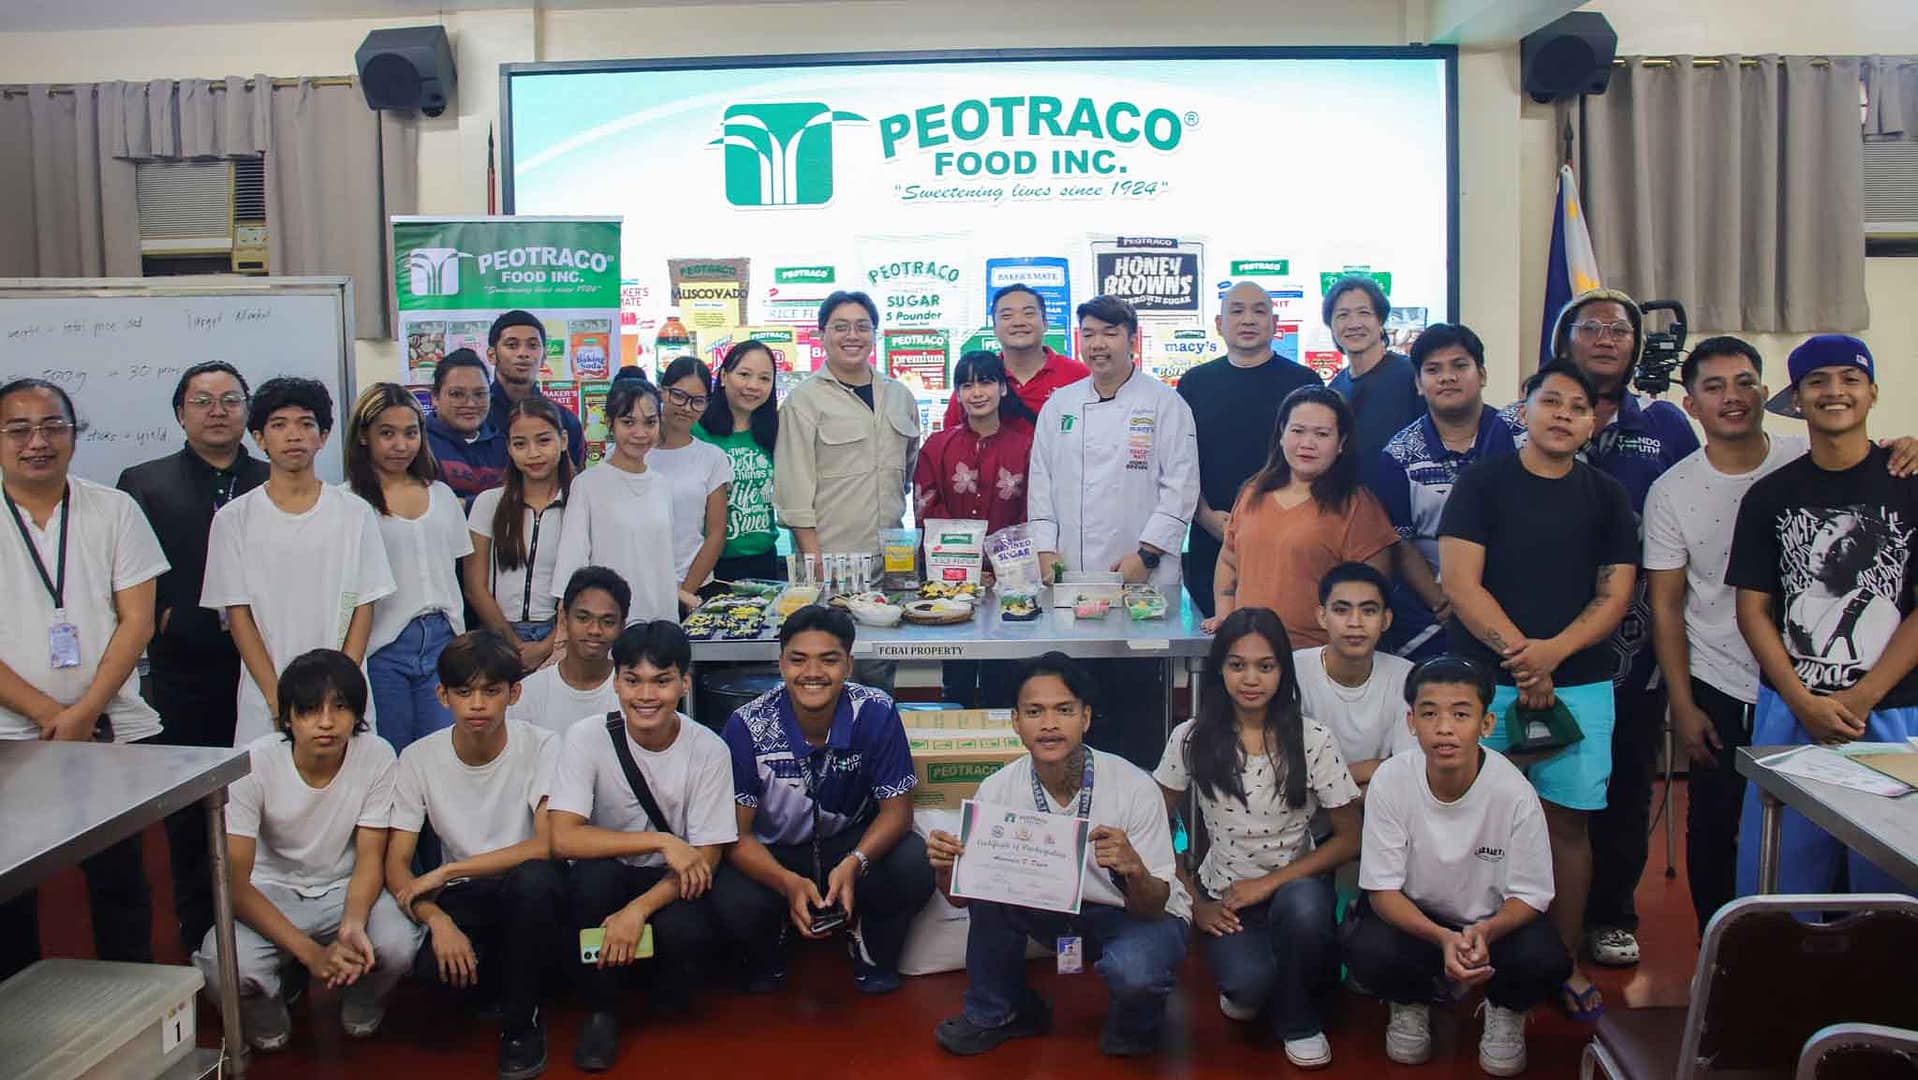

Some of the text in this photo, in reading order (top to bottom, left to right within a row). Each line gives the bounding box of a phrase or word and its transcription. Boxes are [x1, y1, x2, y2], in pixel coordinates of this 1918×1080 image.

[880, 96, 1182, 159] PEOTRACO
[934, 150, 1128, 175] FOOD INC.
[1012, 183, 1052, 198] lives
[1059, 184, 1103, 197] since
[478, 247, 607, 275] PEOTRACO
[1115, 256, 1182, 276] HONEY
[501, 271, 584, 283] FOOD INC.
[869, 261, 960, 286] PEOTRACO
[621, 287, 649, 297] KER'S
[1104, 275, 1192, 296] BROWNS
[671, 287, 748, 300] MUSCOVADO
[887, 294, 940, 306] SUGAR
[769, 309, 797, 318] RICE
[896, 311, 942, 321] Pounder
[892, 335, 944, 346] PEOTRACO
[1164, 341, 1217, 354] macy's
[892, 351, 944, 366] premium
[911, 646, 964, 655] PROPERTY
[175, 1021, 181, 1042] 1
